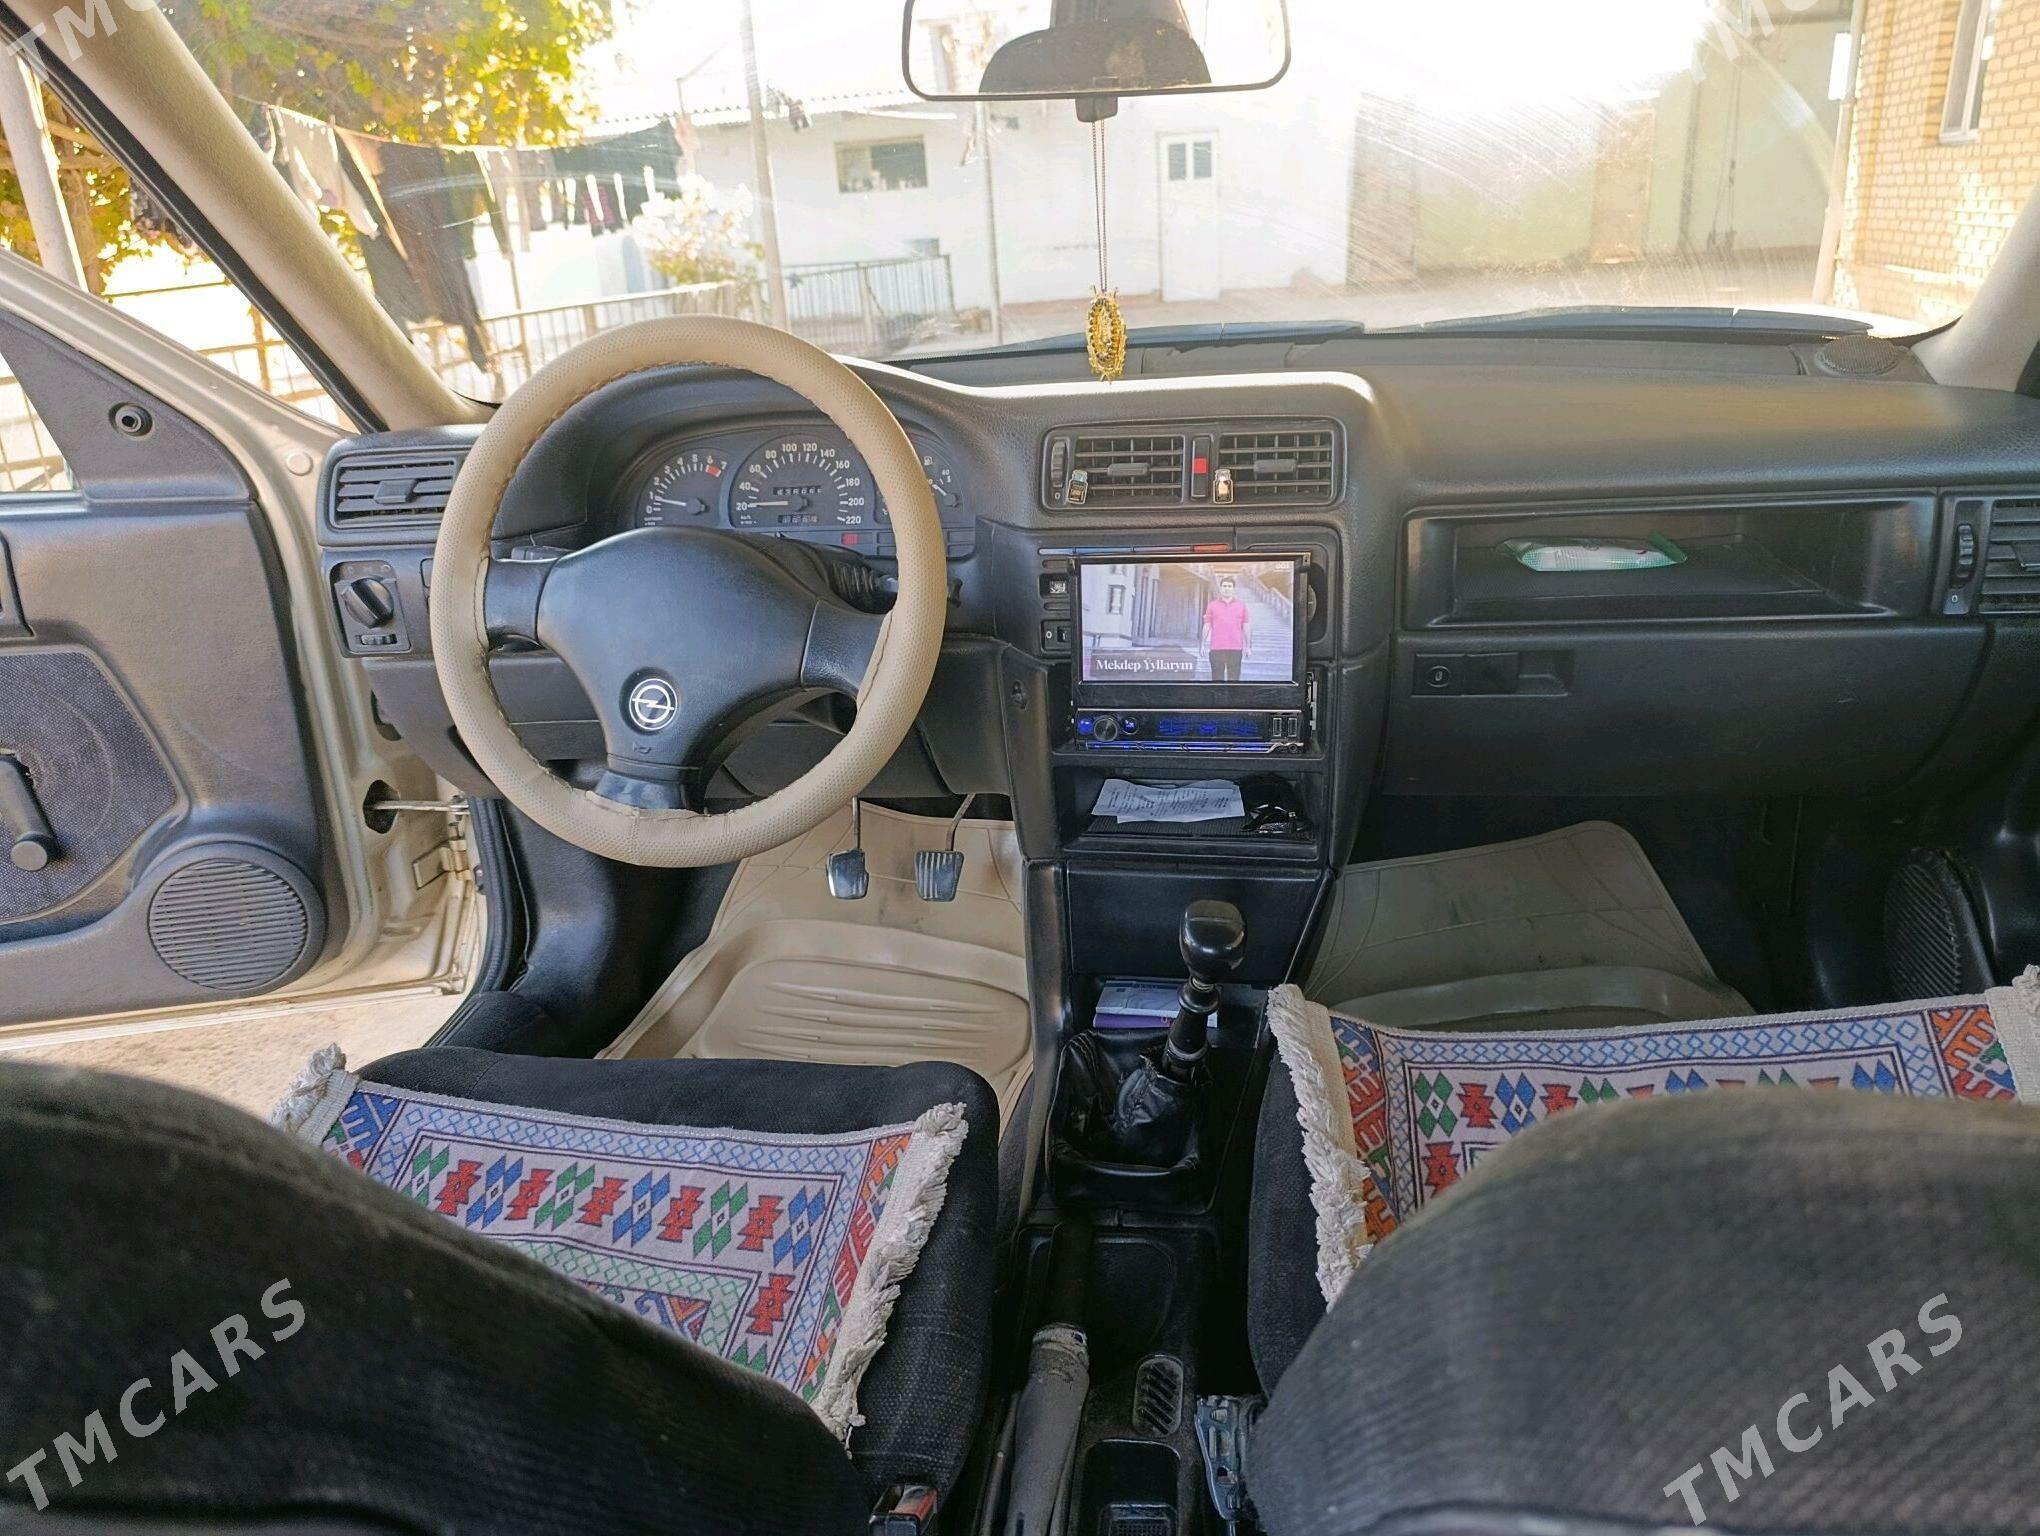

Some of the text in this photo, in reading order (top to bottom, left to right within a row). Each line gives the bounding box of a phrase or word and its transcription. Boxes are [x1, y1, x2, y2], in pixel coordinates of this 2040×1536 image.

[646, 454, 728, 514] 0 1 2 3 4 5 6 7
[736, 443, 865, 525] 20 40 60 80 100 120 140 160 180 200 220
[1045, 630, 1053, 639] 0
[1096, 659, 1141, 673] Mekdep
